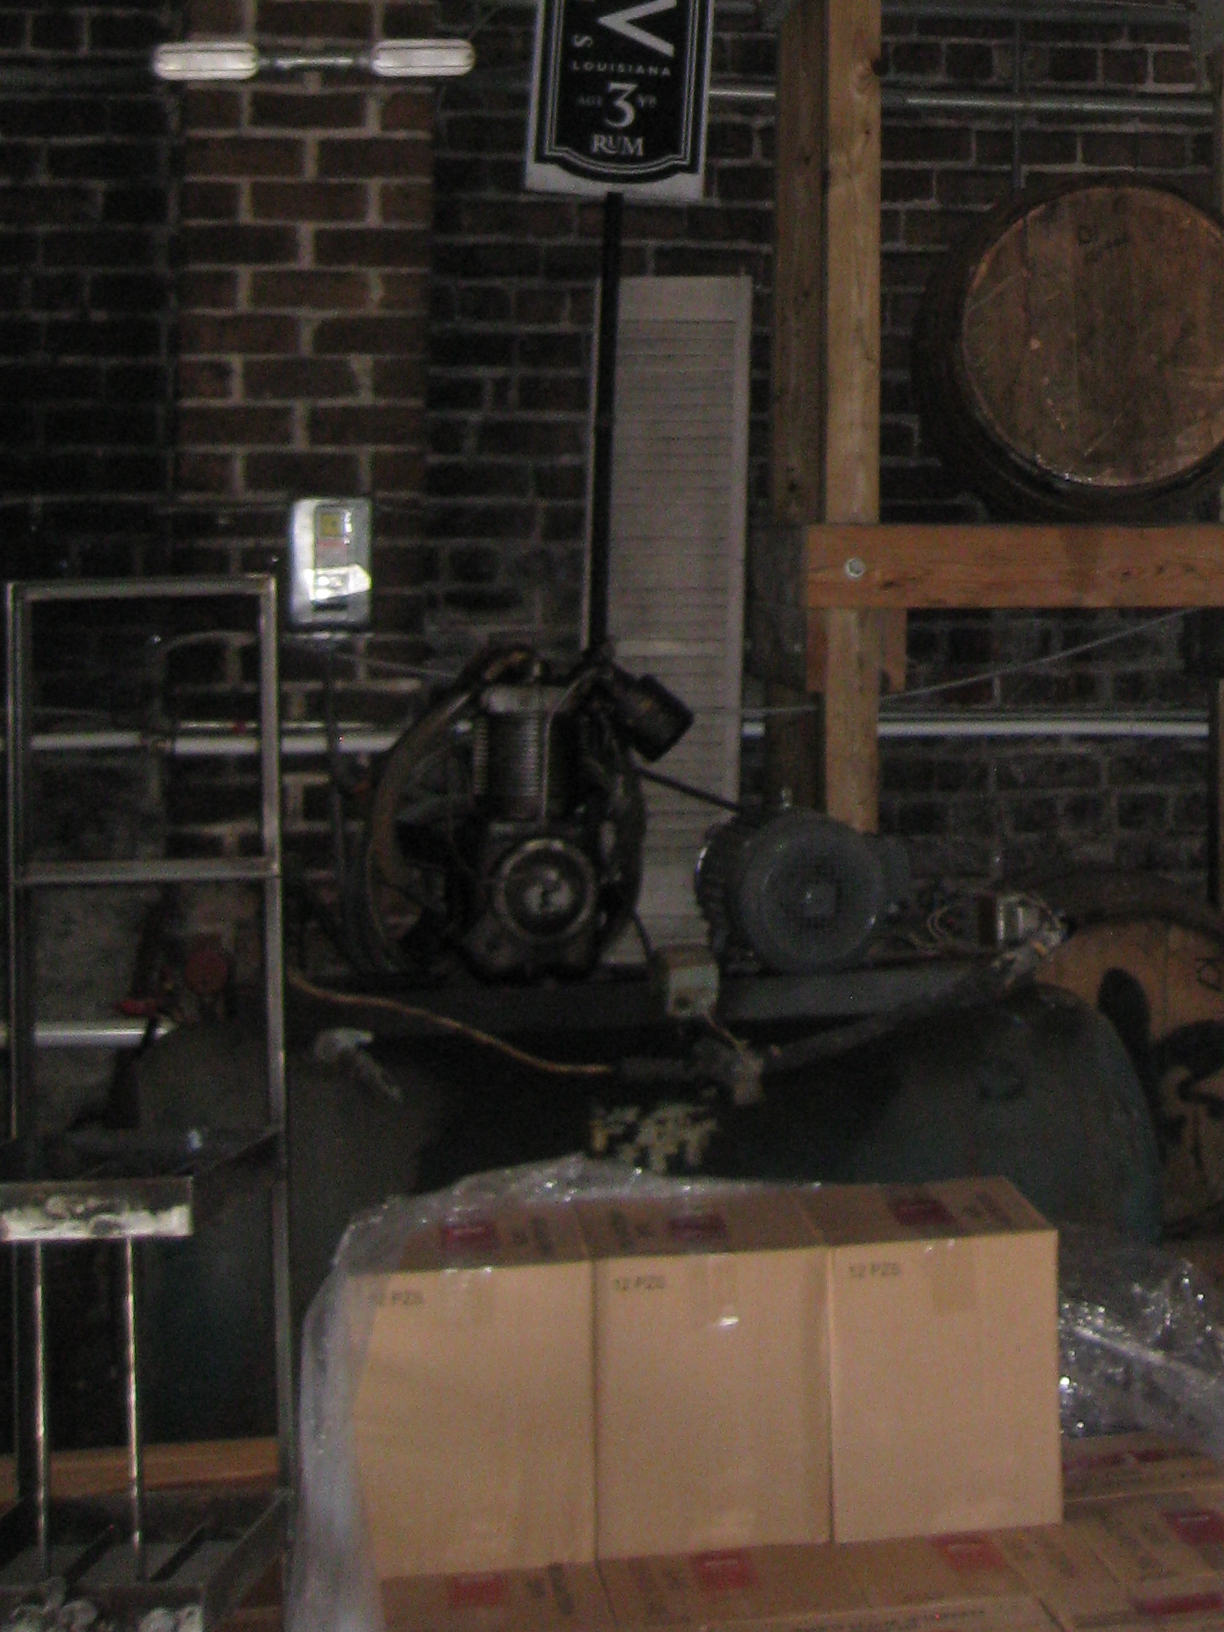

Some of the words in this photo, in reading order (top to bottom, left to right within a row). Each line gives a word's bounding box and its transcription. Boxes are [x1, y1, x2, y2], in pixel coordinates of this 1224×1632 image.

[572, 60, 672, 77] LOUISIANA
[604, 81, 639, 128] 3
[591, 133, 644, 157] RUM
